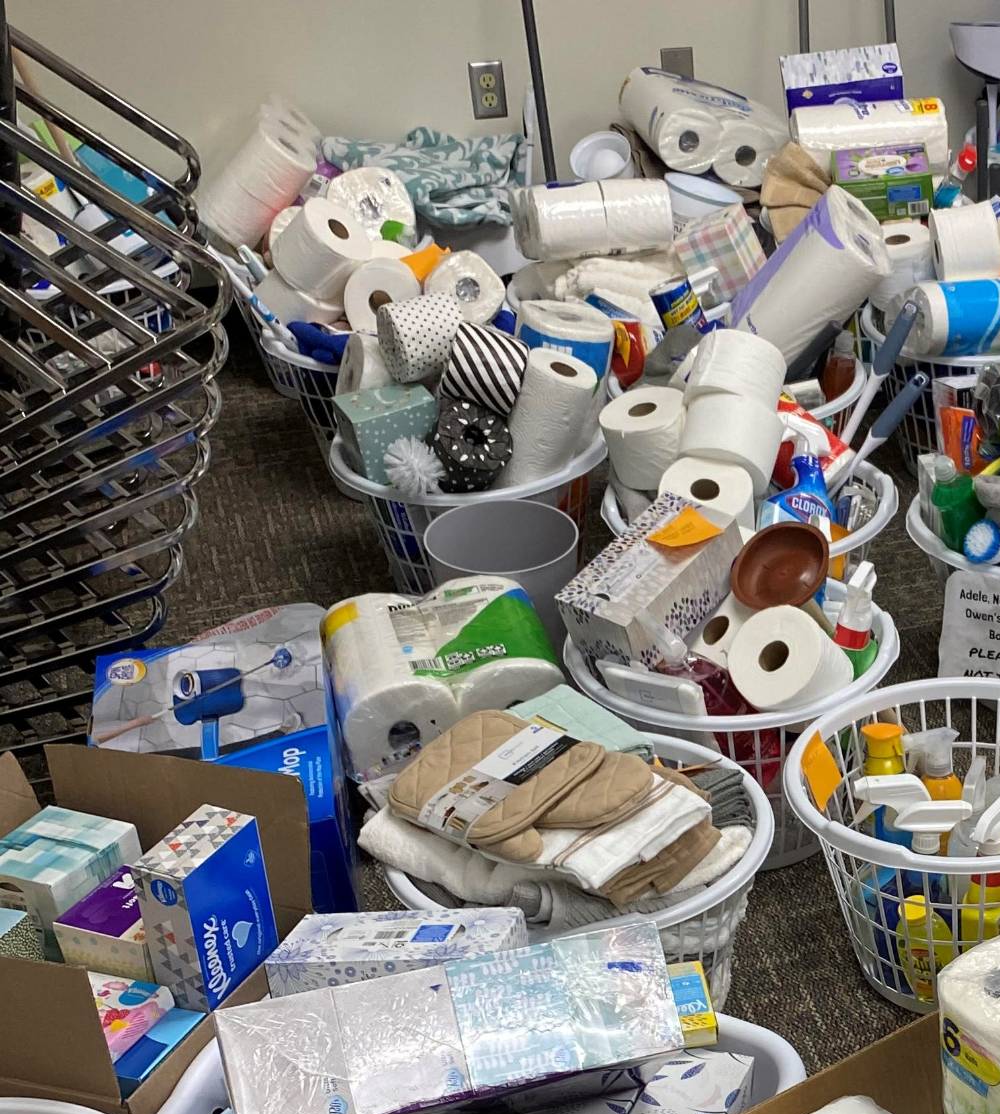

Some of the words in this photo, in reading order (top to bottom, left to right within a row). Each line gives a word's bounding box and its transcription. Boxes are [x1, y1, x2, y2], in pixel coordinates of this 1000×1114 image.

[791, 497, 828, 517] CLOROX
[959, 589, 990, 603] Adele,
[278, 747, 307, 776] Mop
[220, 919, 230, 940] care
[203, 914, 231, 1000] Kleenex
[224, 938, 236, 972] trusted
[943, 1017, 961, 1057] 6
